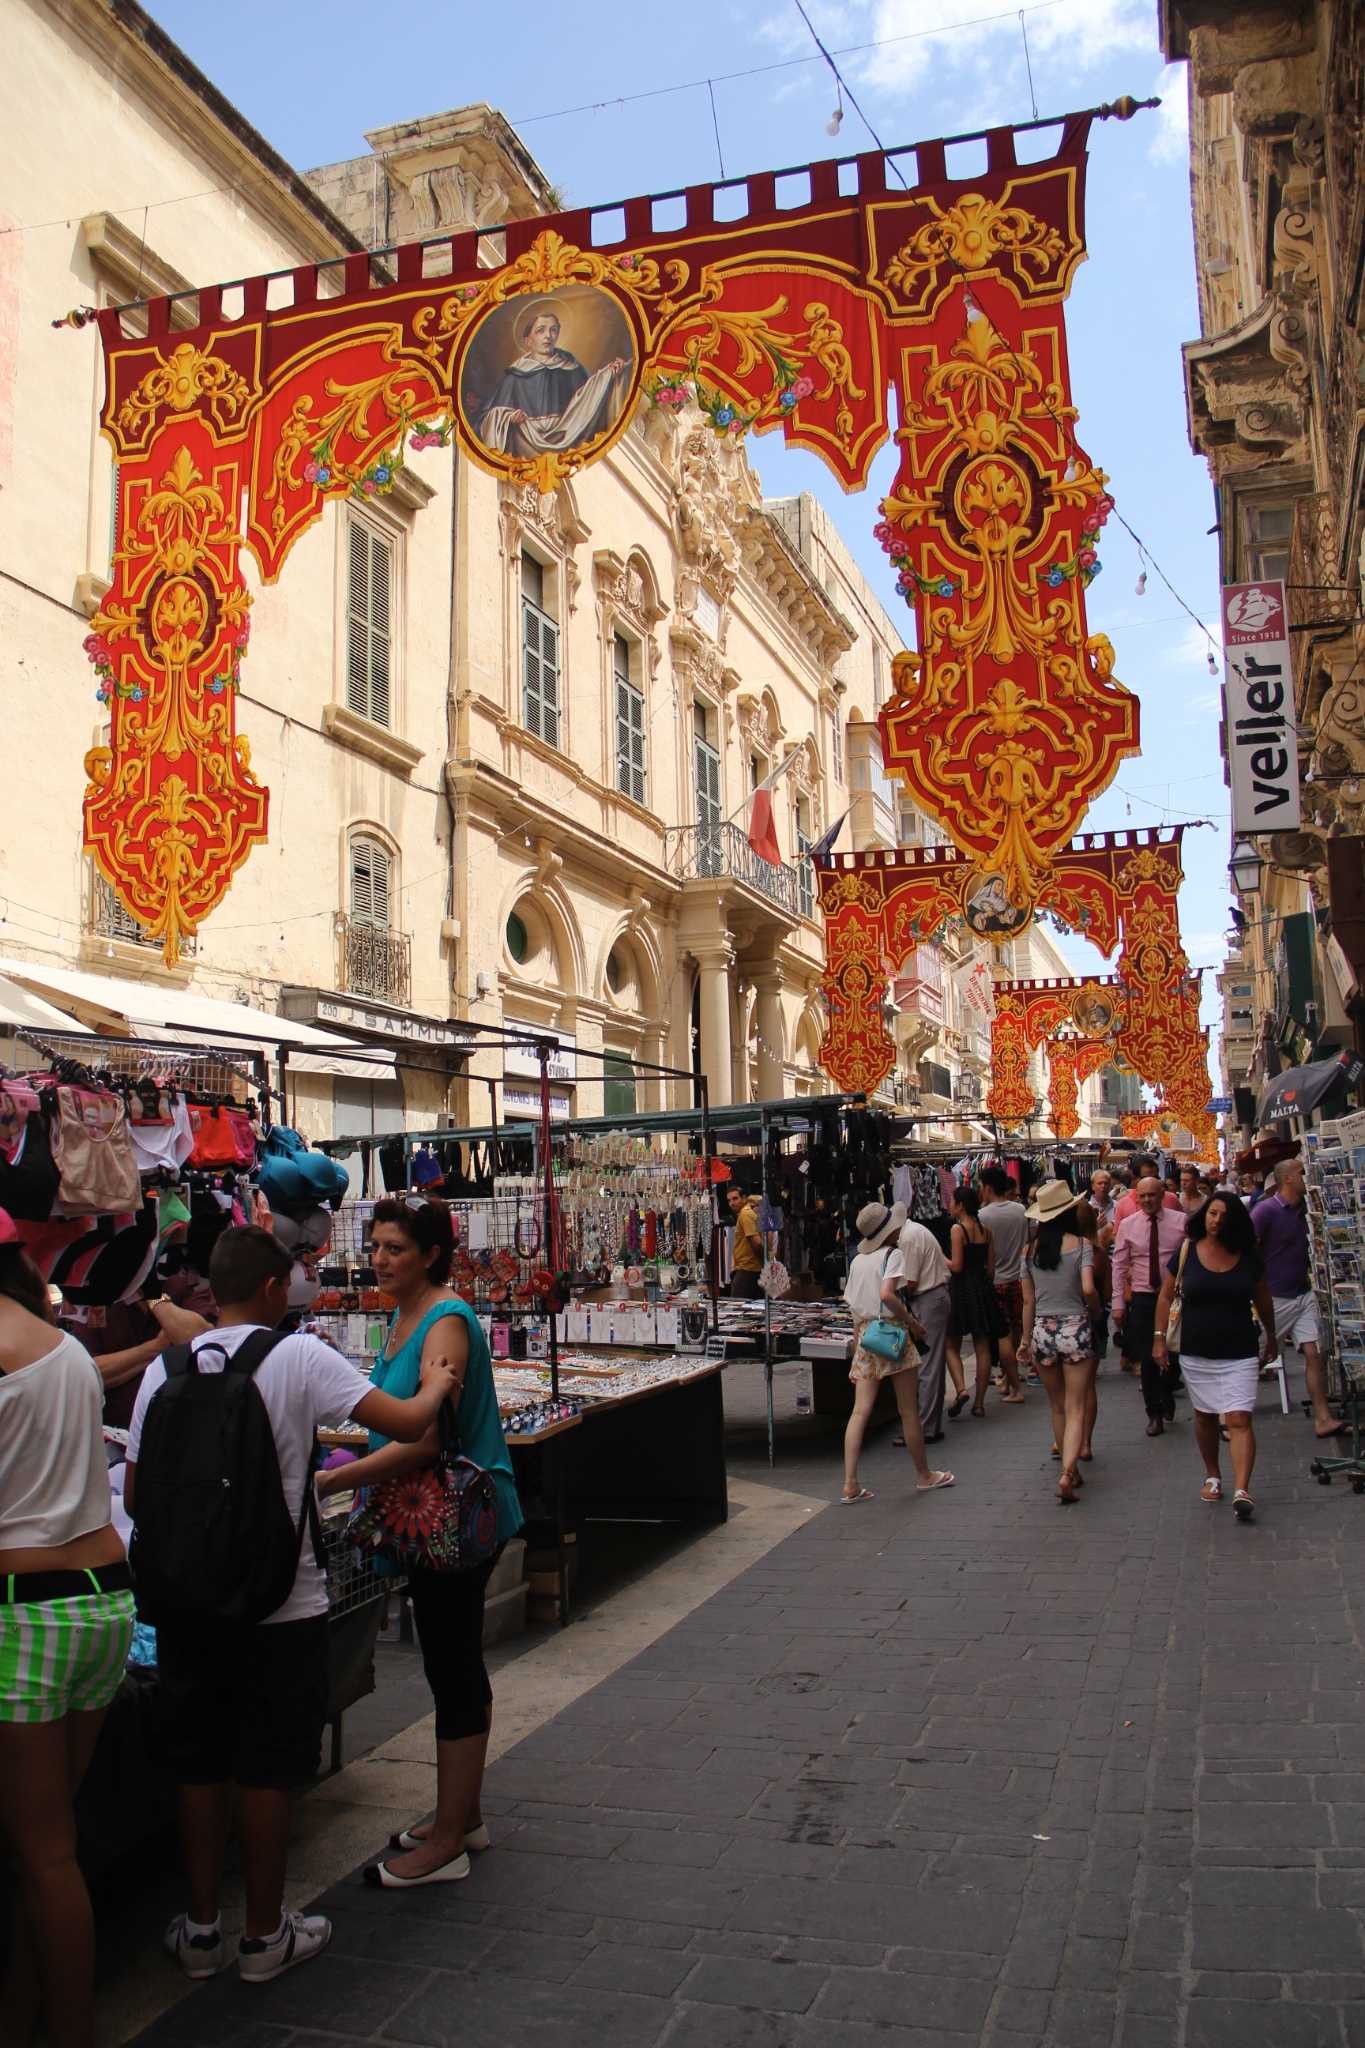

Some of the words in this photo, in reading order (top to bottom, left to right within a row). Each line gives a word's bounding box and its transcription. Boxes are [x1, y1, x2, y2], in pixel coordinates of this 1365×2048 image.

[1231, 634, 1256, 643] Since
[1259, 631, 1280, 640] 1918
[1235, 656, 1290, 816] veller
[965, 988, 981, 1012] TOURS
[969, 976, 991, 1014] BRITANNIA
[322, 1004, 338, 1018] 200
[364, 1012, 460, 1044] SAMMUT
[1347, 1060, 1364, 1083] MALTA
[503, 1088, 530, 1105] OUVENIRS
[1270, 1103, 1299, 1119] MALTA
